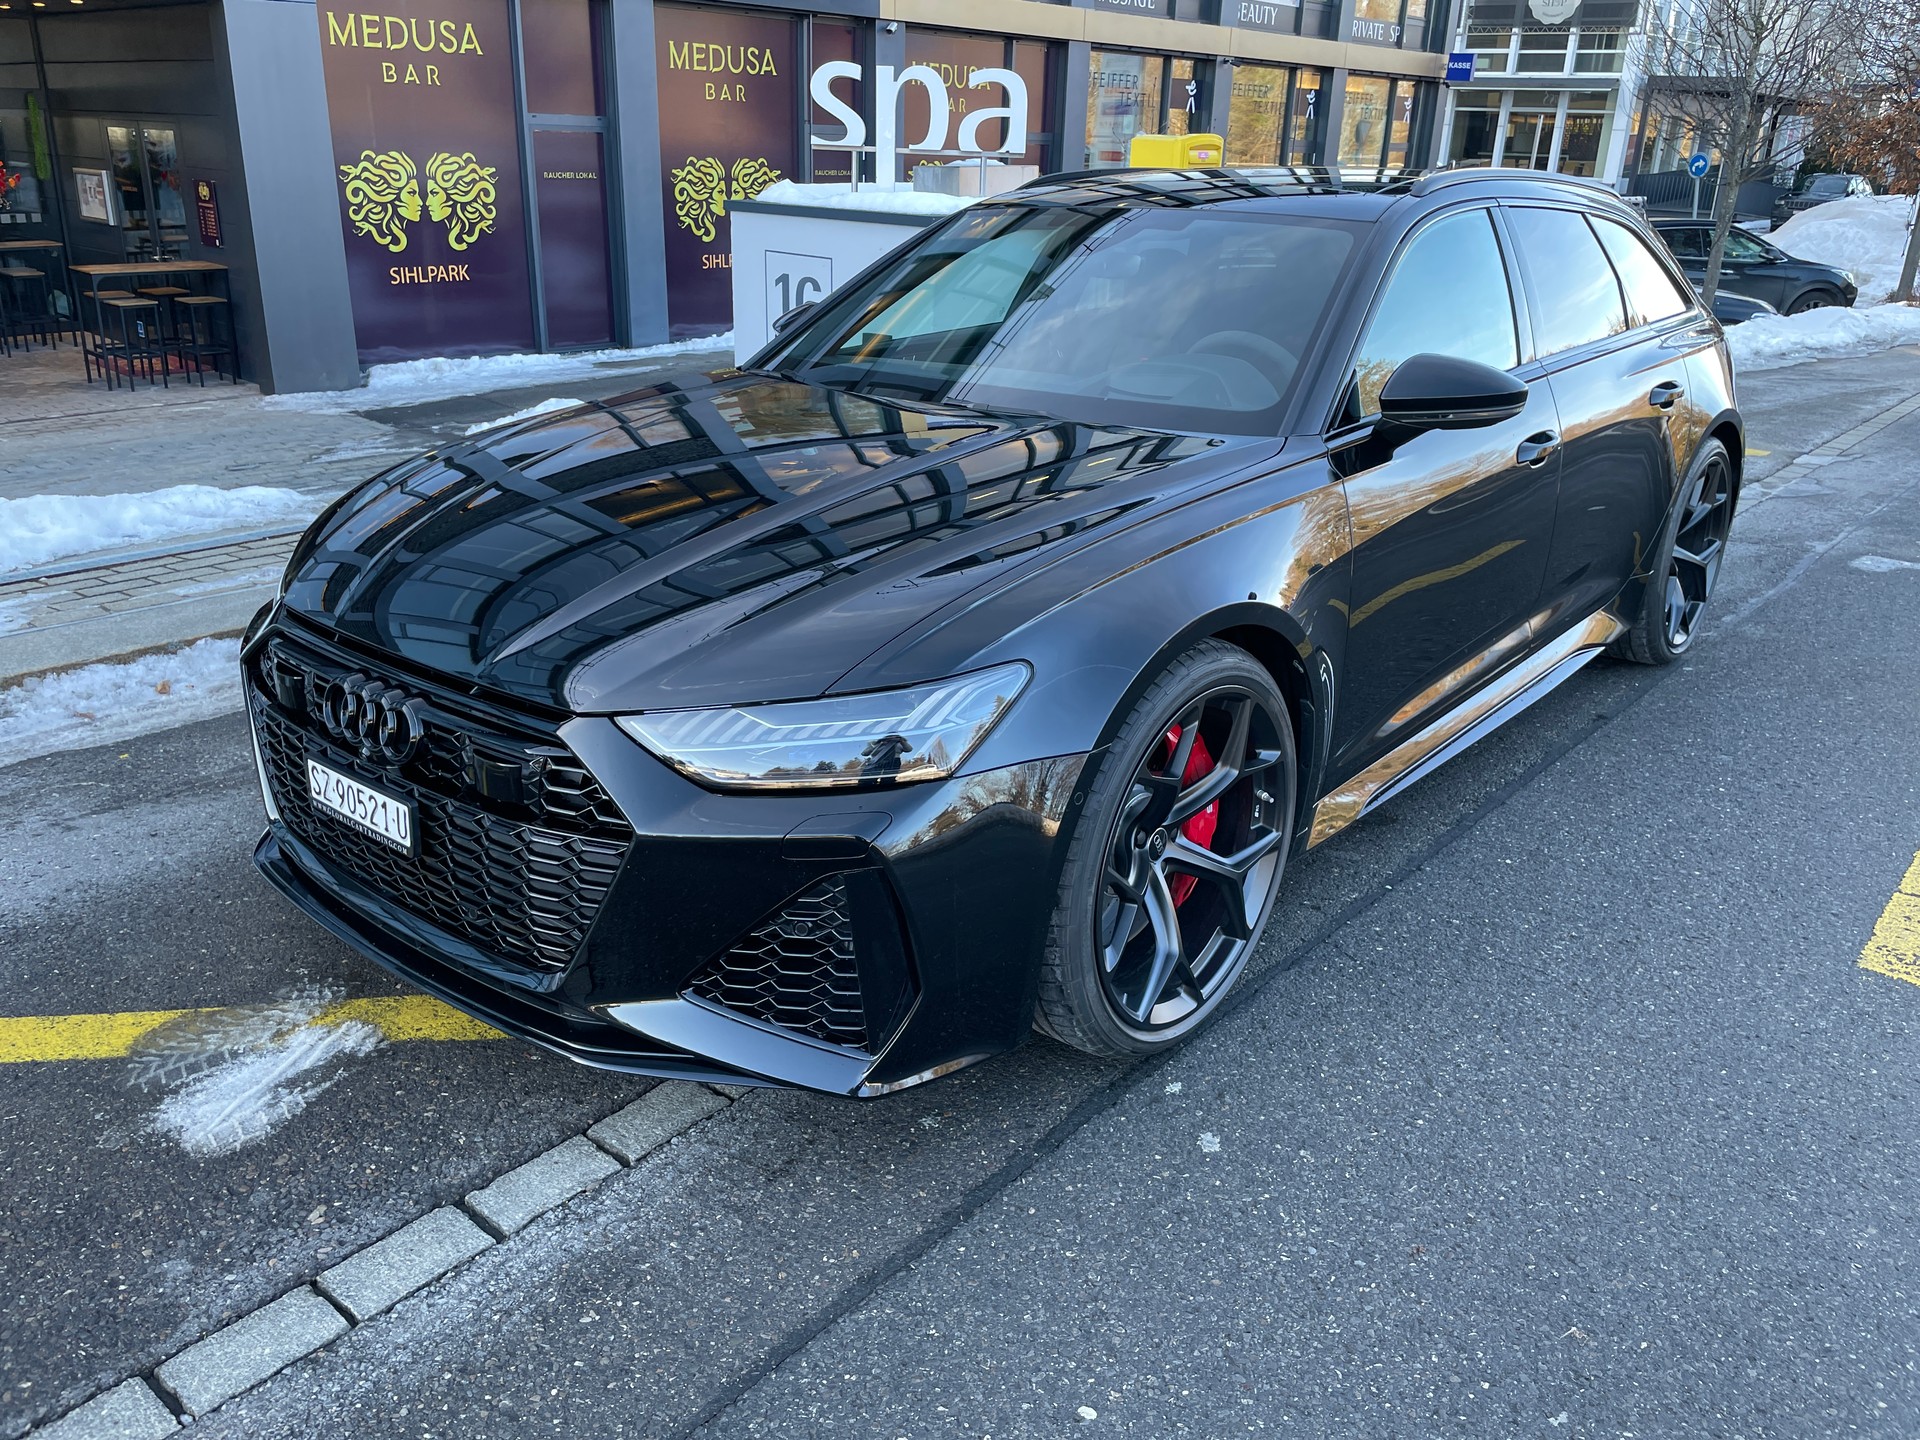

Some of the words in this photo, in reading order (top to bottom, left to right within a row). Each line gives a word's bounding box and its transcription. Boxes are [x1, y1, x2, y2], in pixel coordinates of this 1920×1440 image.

[1238, 2, 1278, 26] EAUTY
[326, 11, 484, 56] MEDUSA
[1352, 19, 1385, 41] RIVATE
[668, 40, 778, 76] MEDUSA
[382, 62, 441, 86] BAR
[705, 82, 747, 102] BAR
[1231, 82, 1269, 99] FEIFFER
[948, 97, 967, 113] AR
[810, 60, 1029, 192] spa
[543, 171, 575, 179] RAUCHER
[389, 264, 470, 285] SIHLPARK
